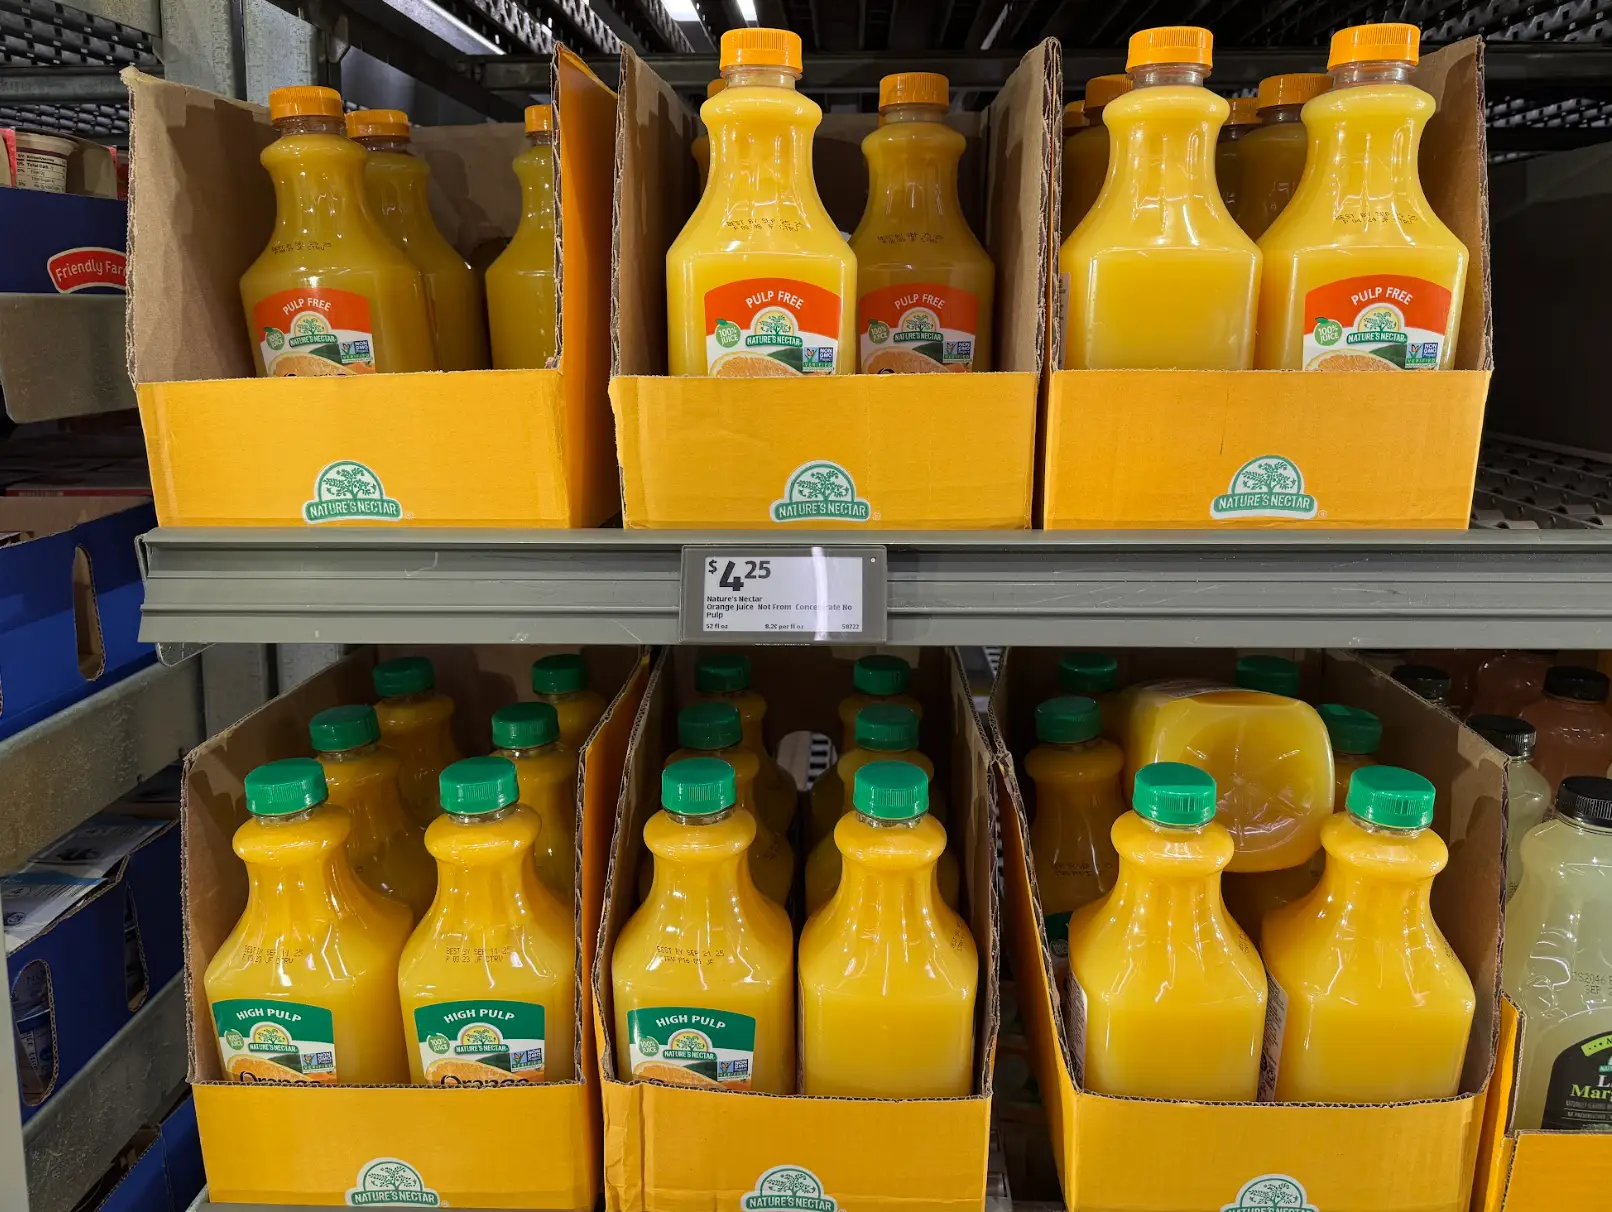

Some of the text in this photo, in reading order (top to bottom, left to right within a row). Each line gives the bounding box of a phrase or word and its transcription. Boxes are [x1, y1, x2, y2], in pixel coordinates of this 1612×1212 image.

[56, 258, 102, 282] Friendly
[745, 291, 804, 310] PULP FREE
[894, 294, 946, 309] PULP FREE
[1351, 287, 1413, 305] PULP FREE
[283, 297, 331, 315] PULP FREE
[718, 330, 739, 345] 100% JUICE
[746, 334, 800, 346] NATURE'S NECTAR
[1318, 326, 1339, 343] 100% JUICE
[1348, 332, 1405, 342] NATURE'S NECTAR
[1219, 494, 1310, 509] NATURE'S NECTAR
[310, 501, 396, 518] NATURE'S NECTAR
[780, 502, 866, 518] NATURE'S NECTAR
[236, 1008, 302, 1022] HIGH PULP
[444, 1009, 516, 1023] HIGH PULP
[656, 1015, 726, 1029] HIGH PULP
[355, 1191, 435, 1203] NATURE'S NECTAR
[750, 1196, 831, 1211] NATURE'S NECTAR
